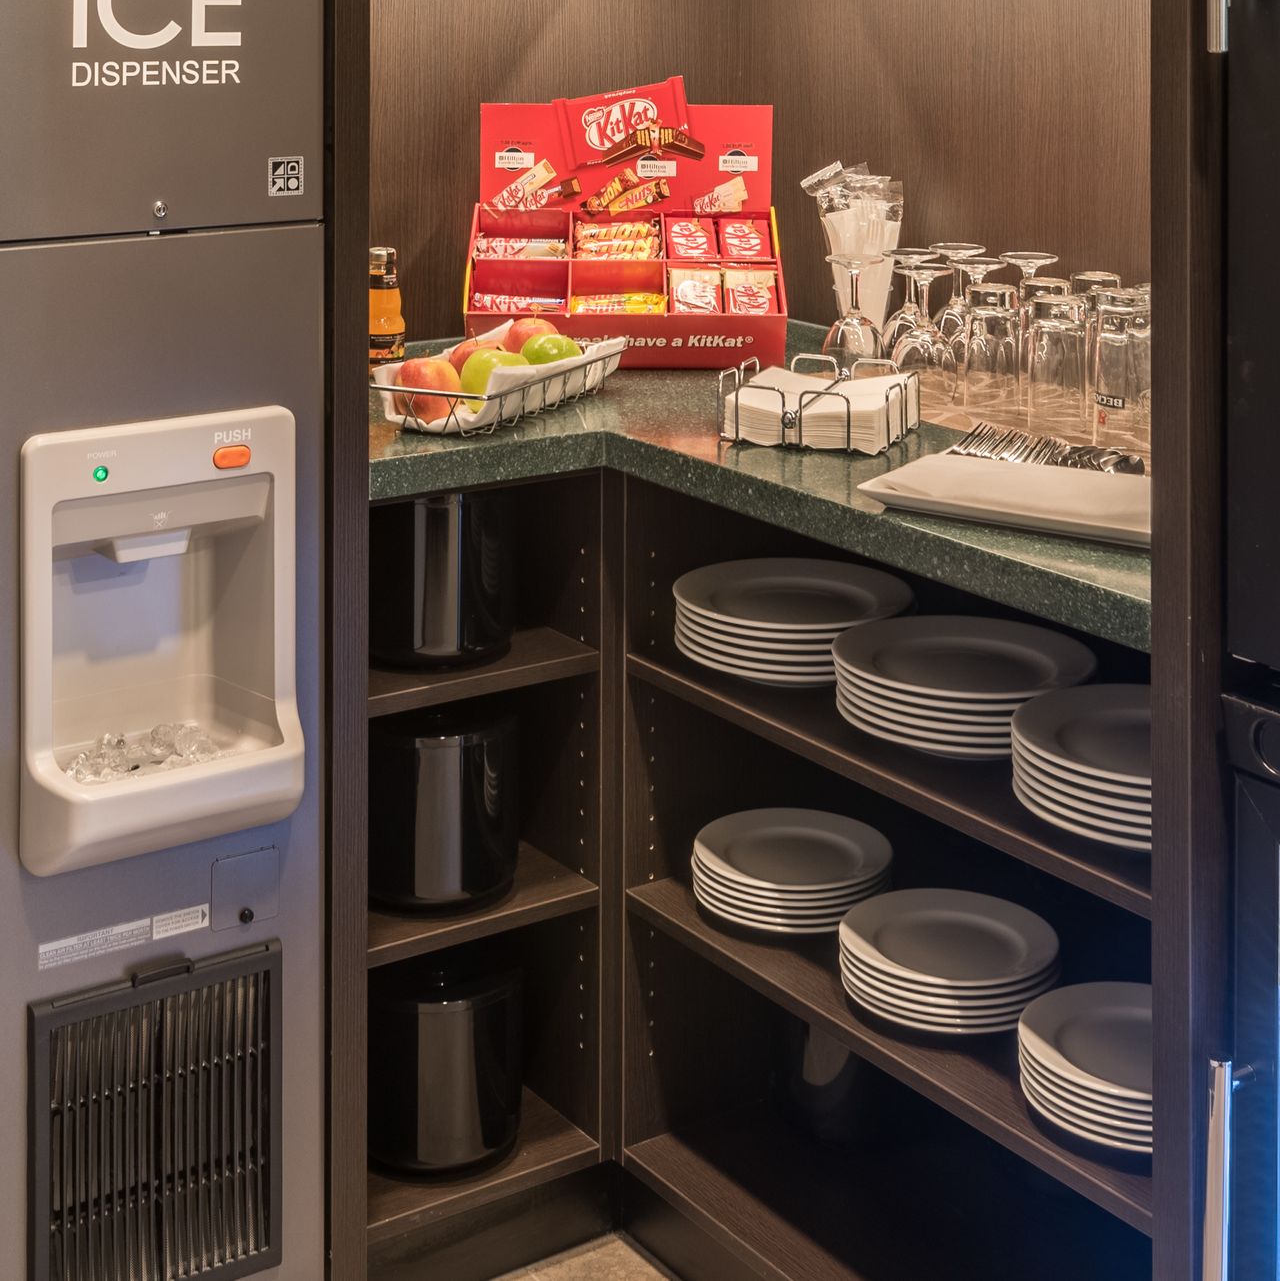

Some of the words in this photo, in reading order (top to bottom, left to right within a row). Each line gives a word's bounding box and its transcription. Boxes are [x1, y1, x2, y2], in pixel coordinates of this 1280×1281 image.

[71, 60, 241, 87] DISPENSER
[596, 102, 651, 147] KitKat
[600, 177, 623, 207] LION
[625, 335, 667, 347] have
[672, 337, 683, 347] a
[214, 428, 252, 444] PUSH
[87, 450, 117, 460] POWER
[76, 928, 114, 942] IMPORTANT
